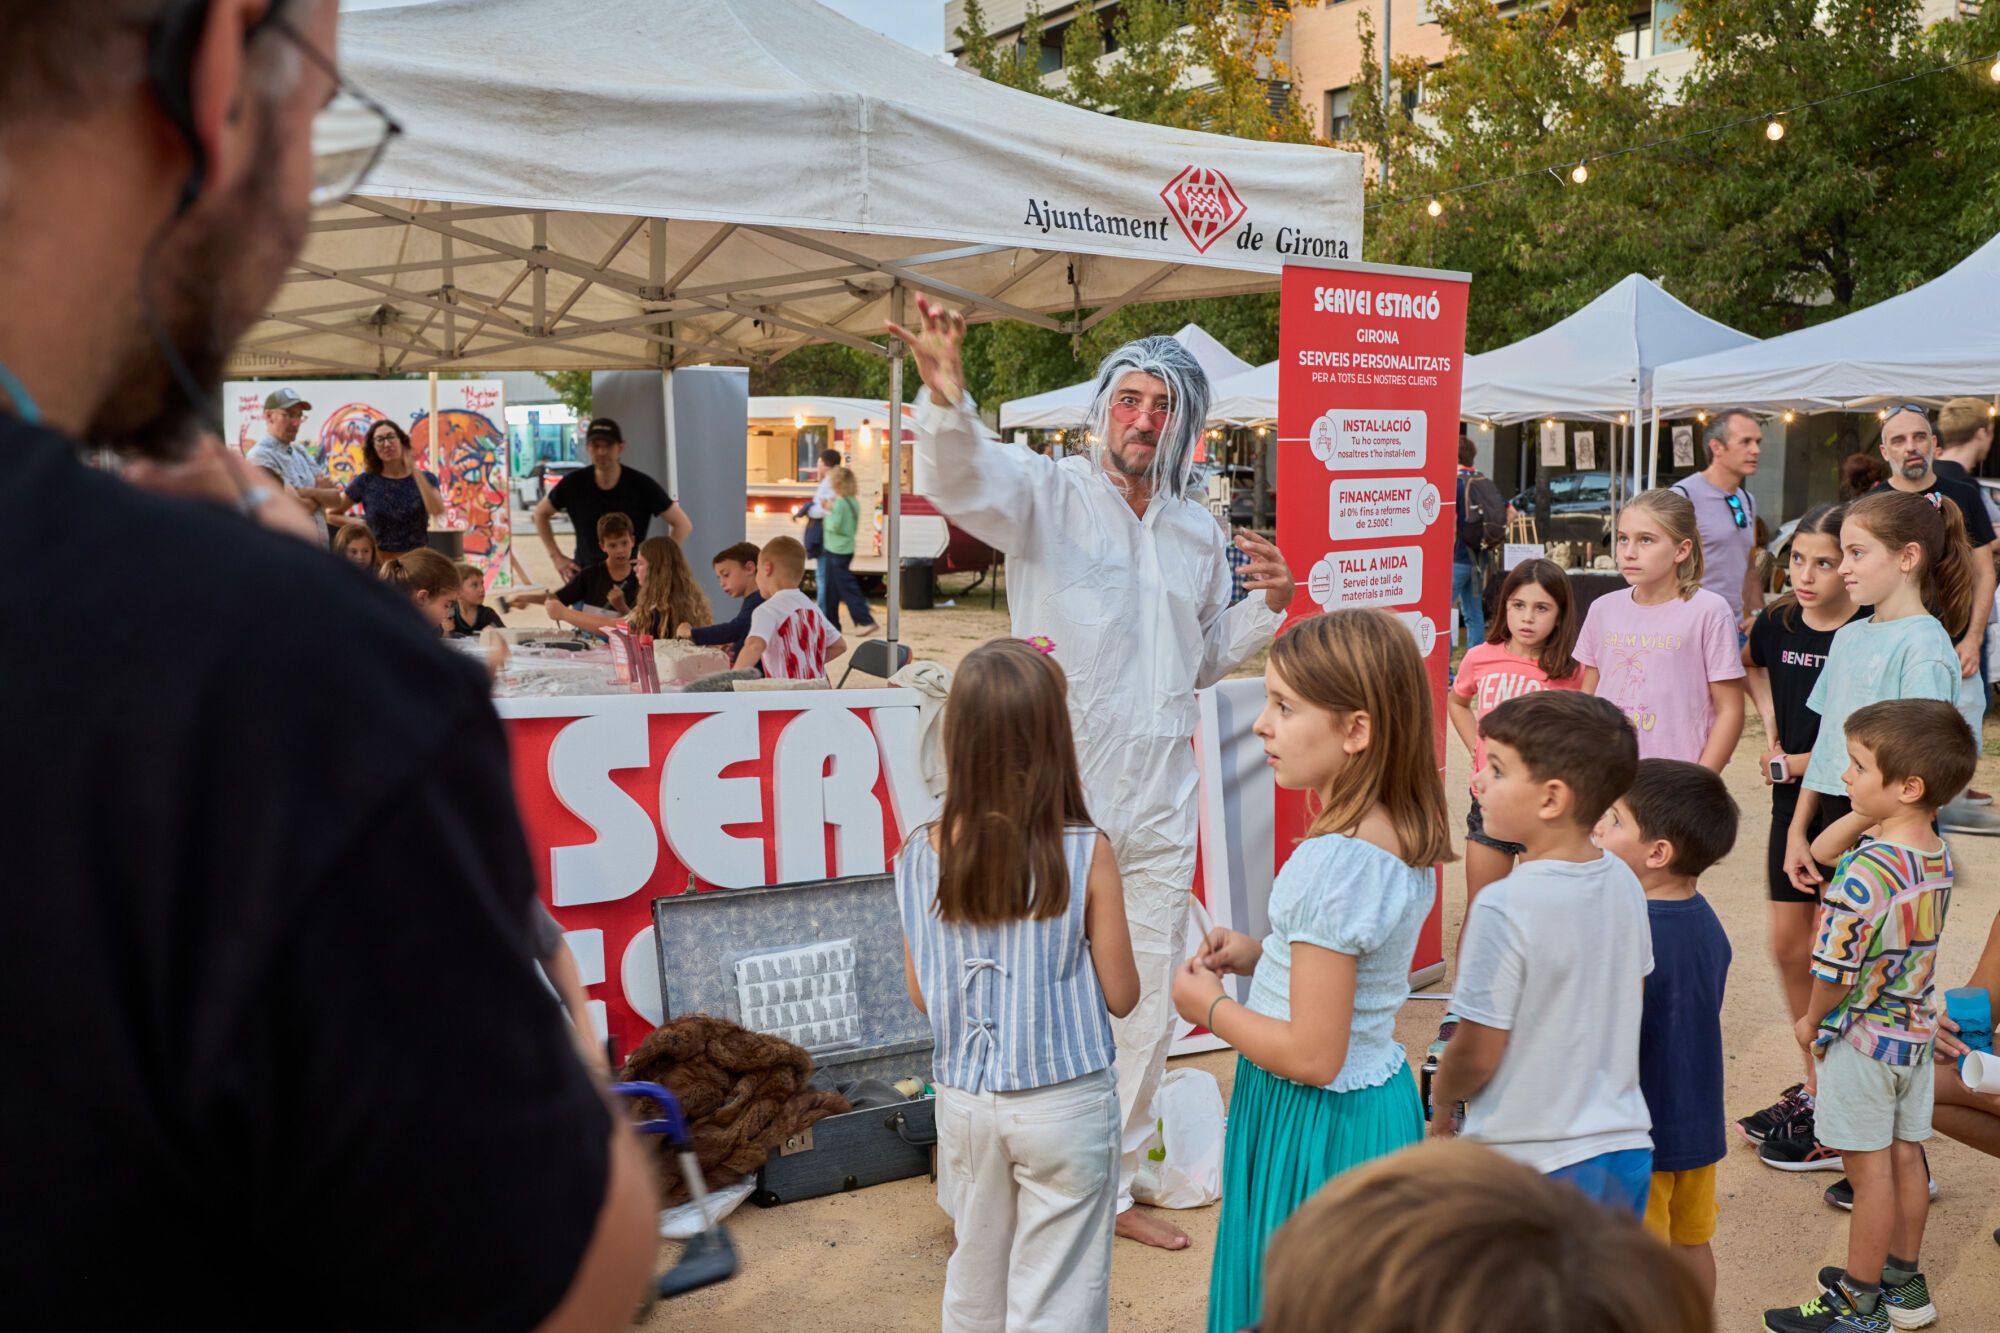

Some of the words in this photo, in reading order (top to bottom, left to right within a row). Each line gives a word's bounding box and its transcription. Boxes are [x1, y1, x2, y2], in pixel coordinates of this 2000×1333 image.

[1024, 199, 1169, 241] Ajuntament
[1236, 222, 1263, 251] de
[1276, 227, 1349, 259] Girona
[1314, 287, 1371, 315] SERVEI
[1375, 290, 1441, 320] ESTACIÓ
[1356, 328, 1399, 344] GIRONA
[1298, 350, 1350, 367] SERVEIS
[1352, 353, 1451, 372] PERSONALITZATS
[1312, 372, 1328, 383] PER
[1329, 373, 1336, 383] A
[1337, 373, 1355, 384] TOTS
[1357, 374, 1372, 384] ELS
[1374, 374, 1406, 385] NOSTRES
[1408, 375, 1438, 386] CLIENTS
[1351, 436, 1360, 445] Tu
[1362, 436, 1371, 445] ho
[1372, 438, 1401, 447] compres,
[1337, 449, 1369, 458] nosaltres
[1370, 449, 1382, 458] t'ho
[1339, 489, 1412, 505] FINANÇAMENT
[1339, 508, 1346, 517] al
[1347, 507, 1358, 517] 0%
[1360, 506, 1374, 516] fins
[1380, 505, 1411, 515] reformes
[1356, 520, 1366, 528] de
[1339, 558, 1367, 573] TALL
[1369, 557, 1378, 571] A
[1380, 555, 1408, 570] MIDA
[1343, 575, 1368, 588] Servei
[1369, 576, 1379, 586] de
[1380, 574, 1391, 585] tall
[1392, 573, 1403, 583] de
[1341, 588, 1378, 601] materials
[1378, 590, 1383, 598] a
[1384, 586, 1403, 597] mida
